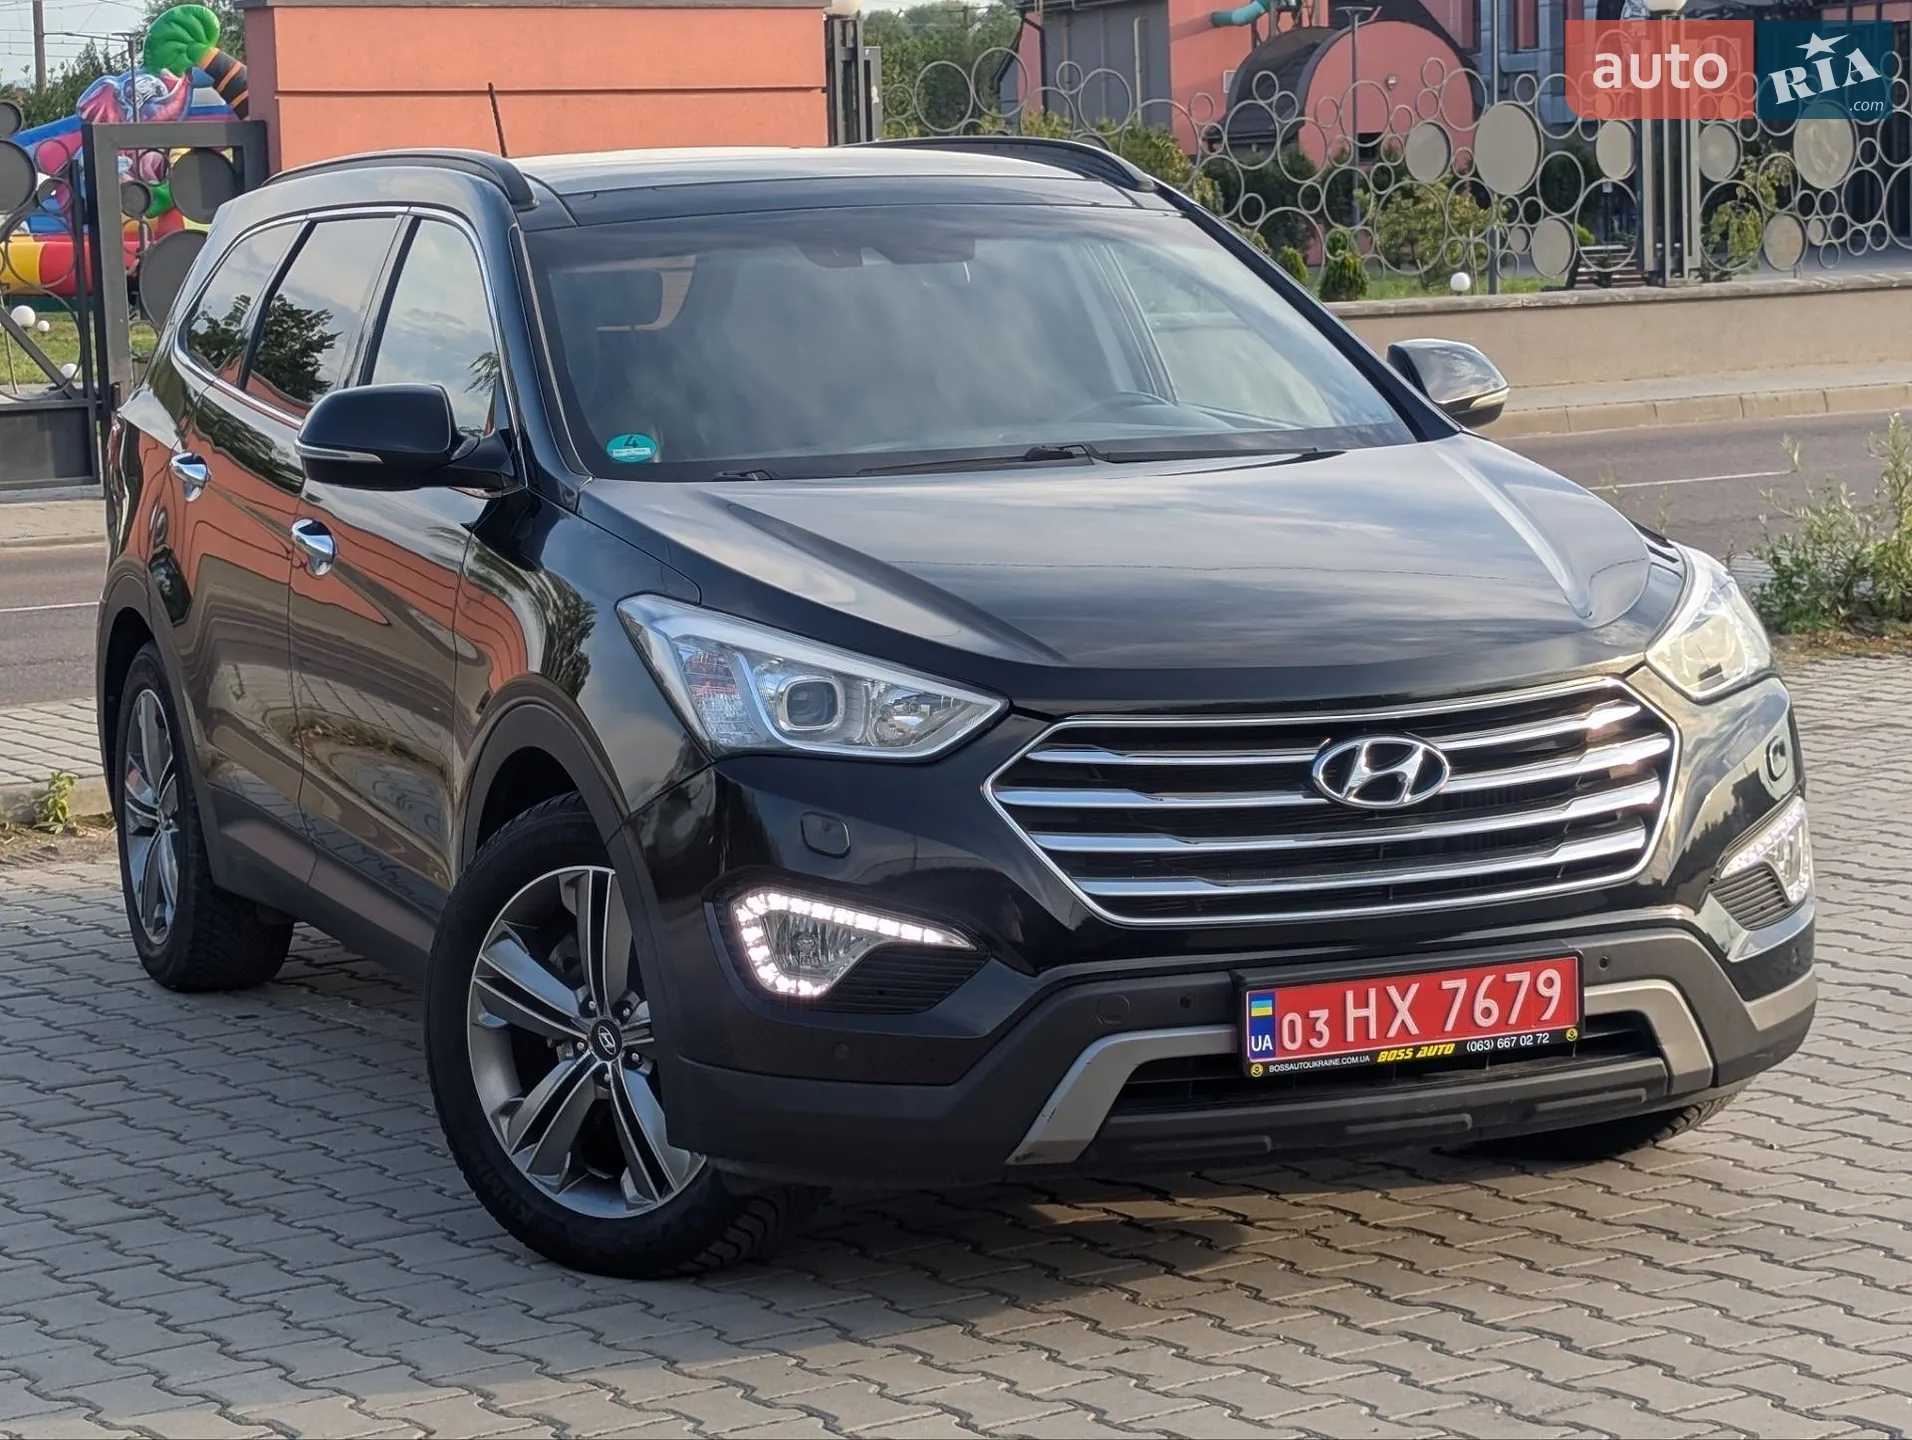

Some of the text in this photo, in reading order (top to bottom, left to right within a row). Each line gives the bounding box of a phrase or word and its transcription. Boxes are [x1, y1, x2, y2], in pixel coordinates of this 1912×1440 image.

[624, 435, 638, 447] 4
[1281, 968, 1562, 1051] 03 HX 7679
[1251, 1034, 1273, 1052] UA
[1268, 1032, 1550, 1073] BOSSAUTOUKRAINE.COM.UA BOSS AUTO (063) 667 02 72
